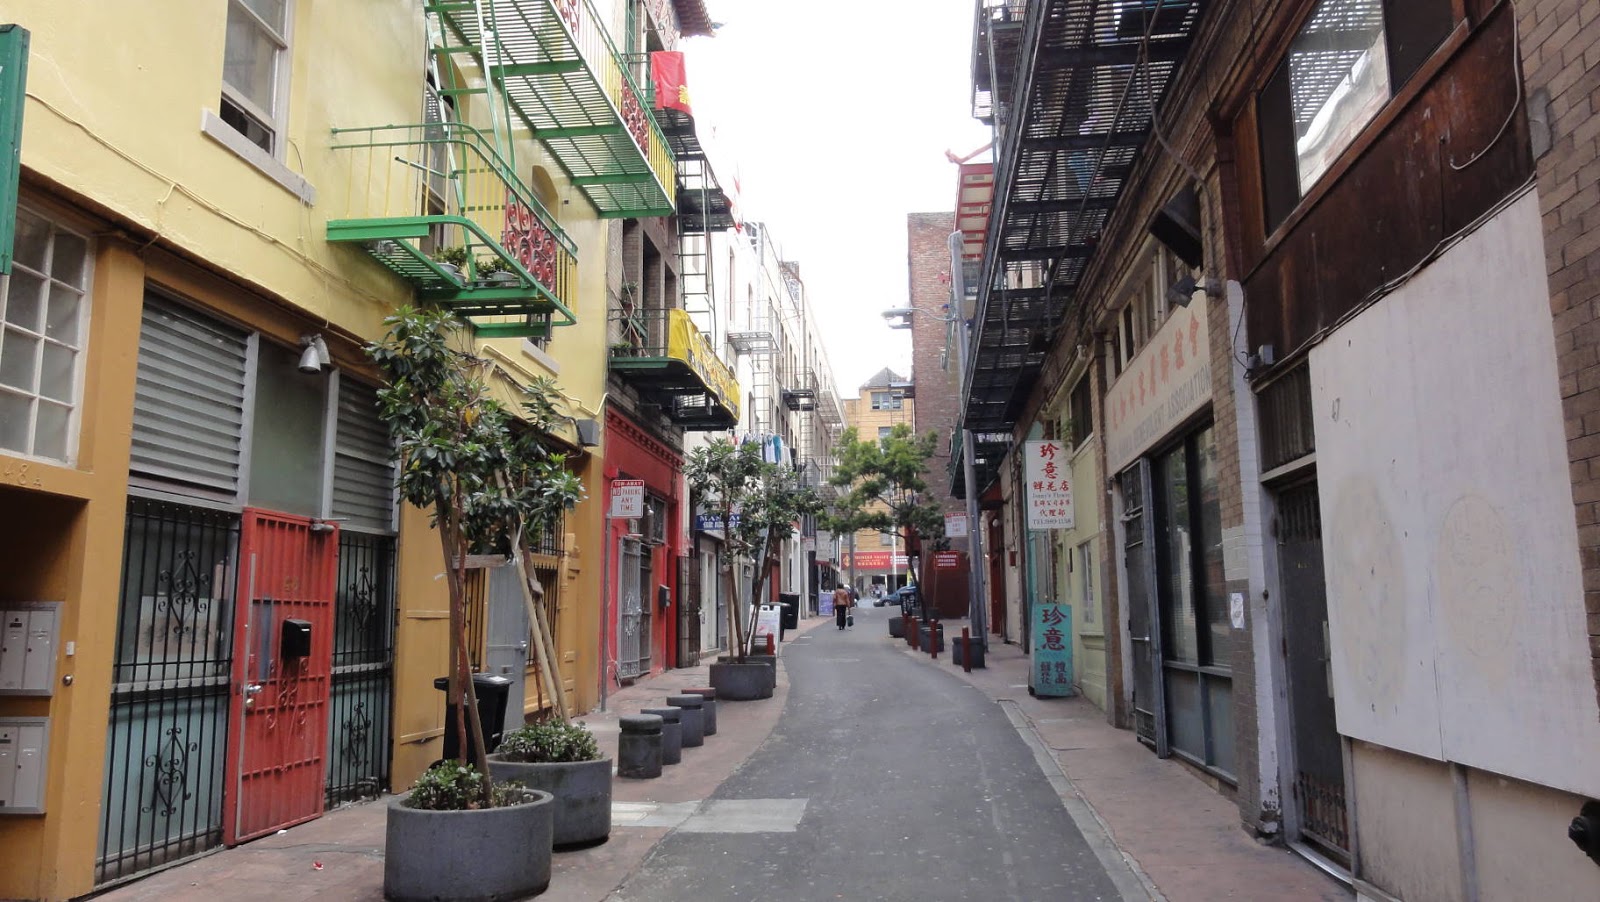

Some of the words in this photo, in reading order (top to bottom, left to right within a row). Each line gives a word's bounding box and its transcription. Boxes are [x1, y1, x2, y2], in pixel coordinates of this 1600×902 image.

[1168, 361, 1212, 421] ASSOCIATION
[613, 487, 621, 496] NO
[622, 488, 641, 496] PARKING
[620, 504, 634, 512] TIME
[1041, 606, 1067, 651] 珍意
